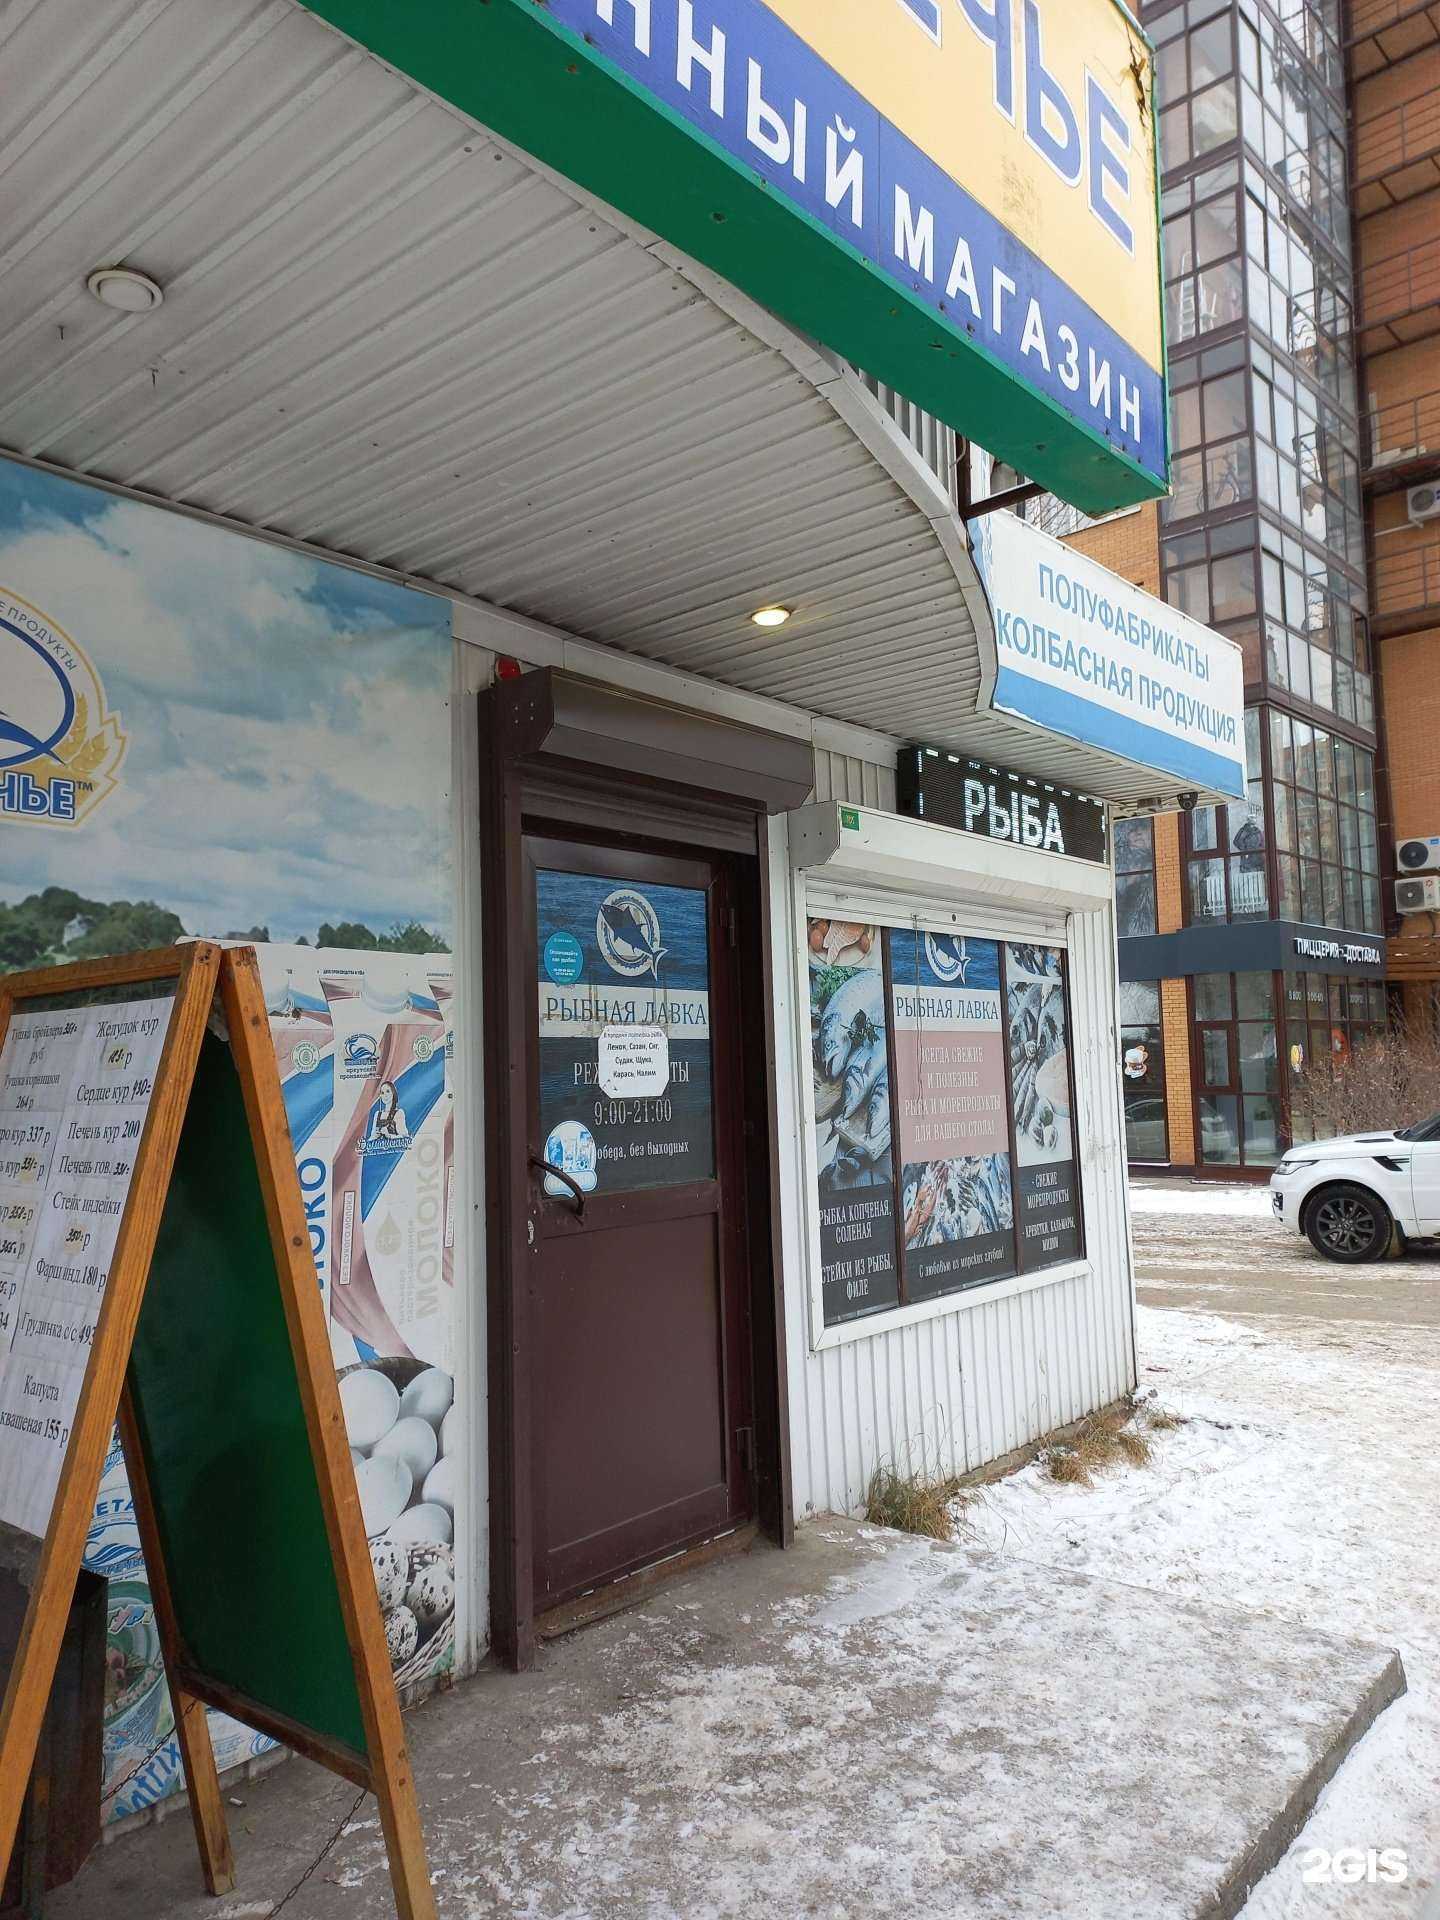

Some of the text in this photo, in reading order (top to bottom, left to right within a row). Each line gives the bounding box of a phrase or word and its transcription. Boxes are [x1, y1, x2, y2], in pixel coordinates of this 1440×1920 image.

[897, 0, 1136, 258] ЧЬЕ
[894, 183, 1141, 443] МАГАЗИН
[1038, 563, 1209, 682] ПОЛУФАБРИКАТЫ
[8, 607, 77, 670] ПРОДУКТЫ
[996, 608, 1236, 745] КОЛБАСНАЯ ПРОДУКЦИЯ
[963, 778, 1065, 854] РЫБА
[546, 997, 707, 1025] РЫБНАЯ ЛАВКА
[895, 996, 999, 1020] РЫБНАЯ ЛАВКА
[96, 1018, 159, 1040] Желудок кур
[123, 1051, 133, 1070] р
[951, 1046, 984, 1063] СВЕЖИЕ
[636, 1069, 657, 1077] Налим
[927, 1071, 979, 1089] И ПОЛЕЗНЫЕ
[76, 1084, 111, 1106] Сердце
[111, 1086, 130, 1104] кур
[930, 1098, 937, 1114] И
[938, 1094, 1000, 1114] МОРЕПРОДУКТЫ
[594, 1099, 673, 1126] 9:00-21:00
[11, 1128, 26, 1147] кур
[27, 1126, 44, 1143] 337
[42, 1131, 51, 1148] р
[67, 1120, 141, 1144] Печень кур 200
[914, 1119, 996, 1144] ДЛЯ ВАШЕГО СТОЛА!
[597, 1144, 627, 1161] обеда,
[629, 1143, 645, 1157] без
[5, 1161, 21, 1179] кур
[37, 1164, 45, 1181] р
[59, 1155, 92, 1174] Печень
[52, 1191, 121, 1215] Стейк индейки
[1027, 1188, 1070, 1209] МОРЕПРОДУКТЫ
[26, 1208, 34, 1226] р
[819, 1199, 892, 1228] РЫБКА КОПЧЕНАЯ,
[416, 1138, 440, 1321] МОЛОКО
[835, 1221, 872, 1244] СОЛЕНАЯ
[82, 1233, 91, 1251] р
[36, 1257, 62, 1283] Фарш
[81, 1265, 98, 1287] 180
[97, 1273, 107, 1293] р
[821, 1252, 894, 1285] СТЕЙКИ ИЗ РЫБЫ,
[8, 1283, 17, 1301] р
[846, 1278, 869, 1301] ФИЛЕ
[21, 1312, 62, 1338] Грудинка
[23, 1375, 60, 1402] Капуста
[0, 1411, 69, 1448] квашеная 155 р
